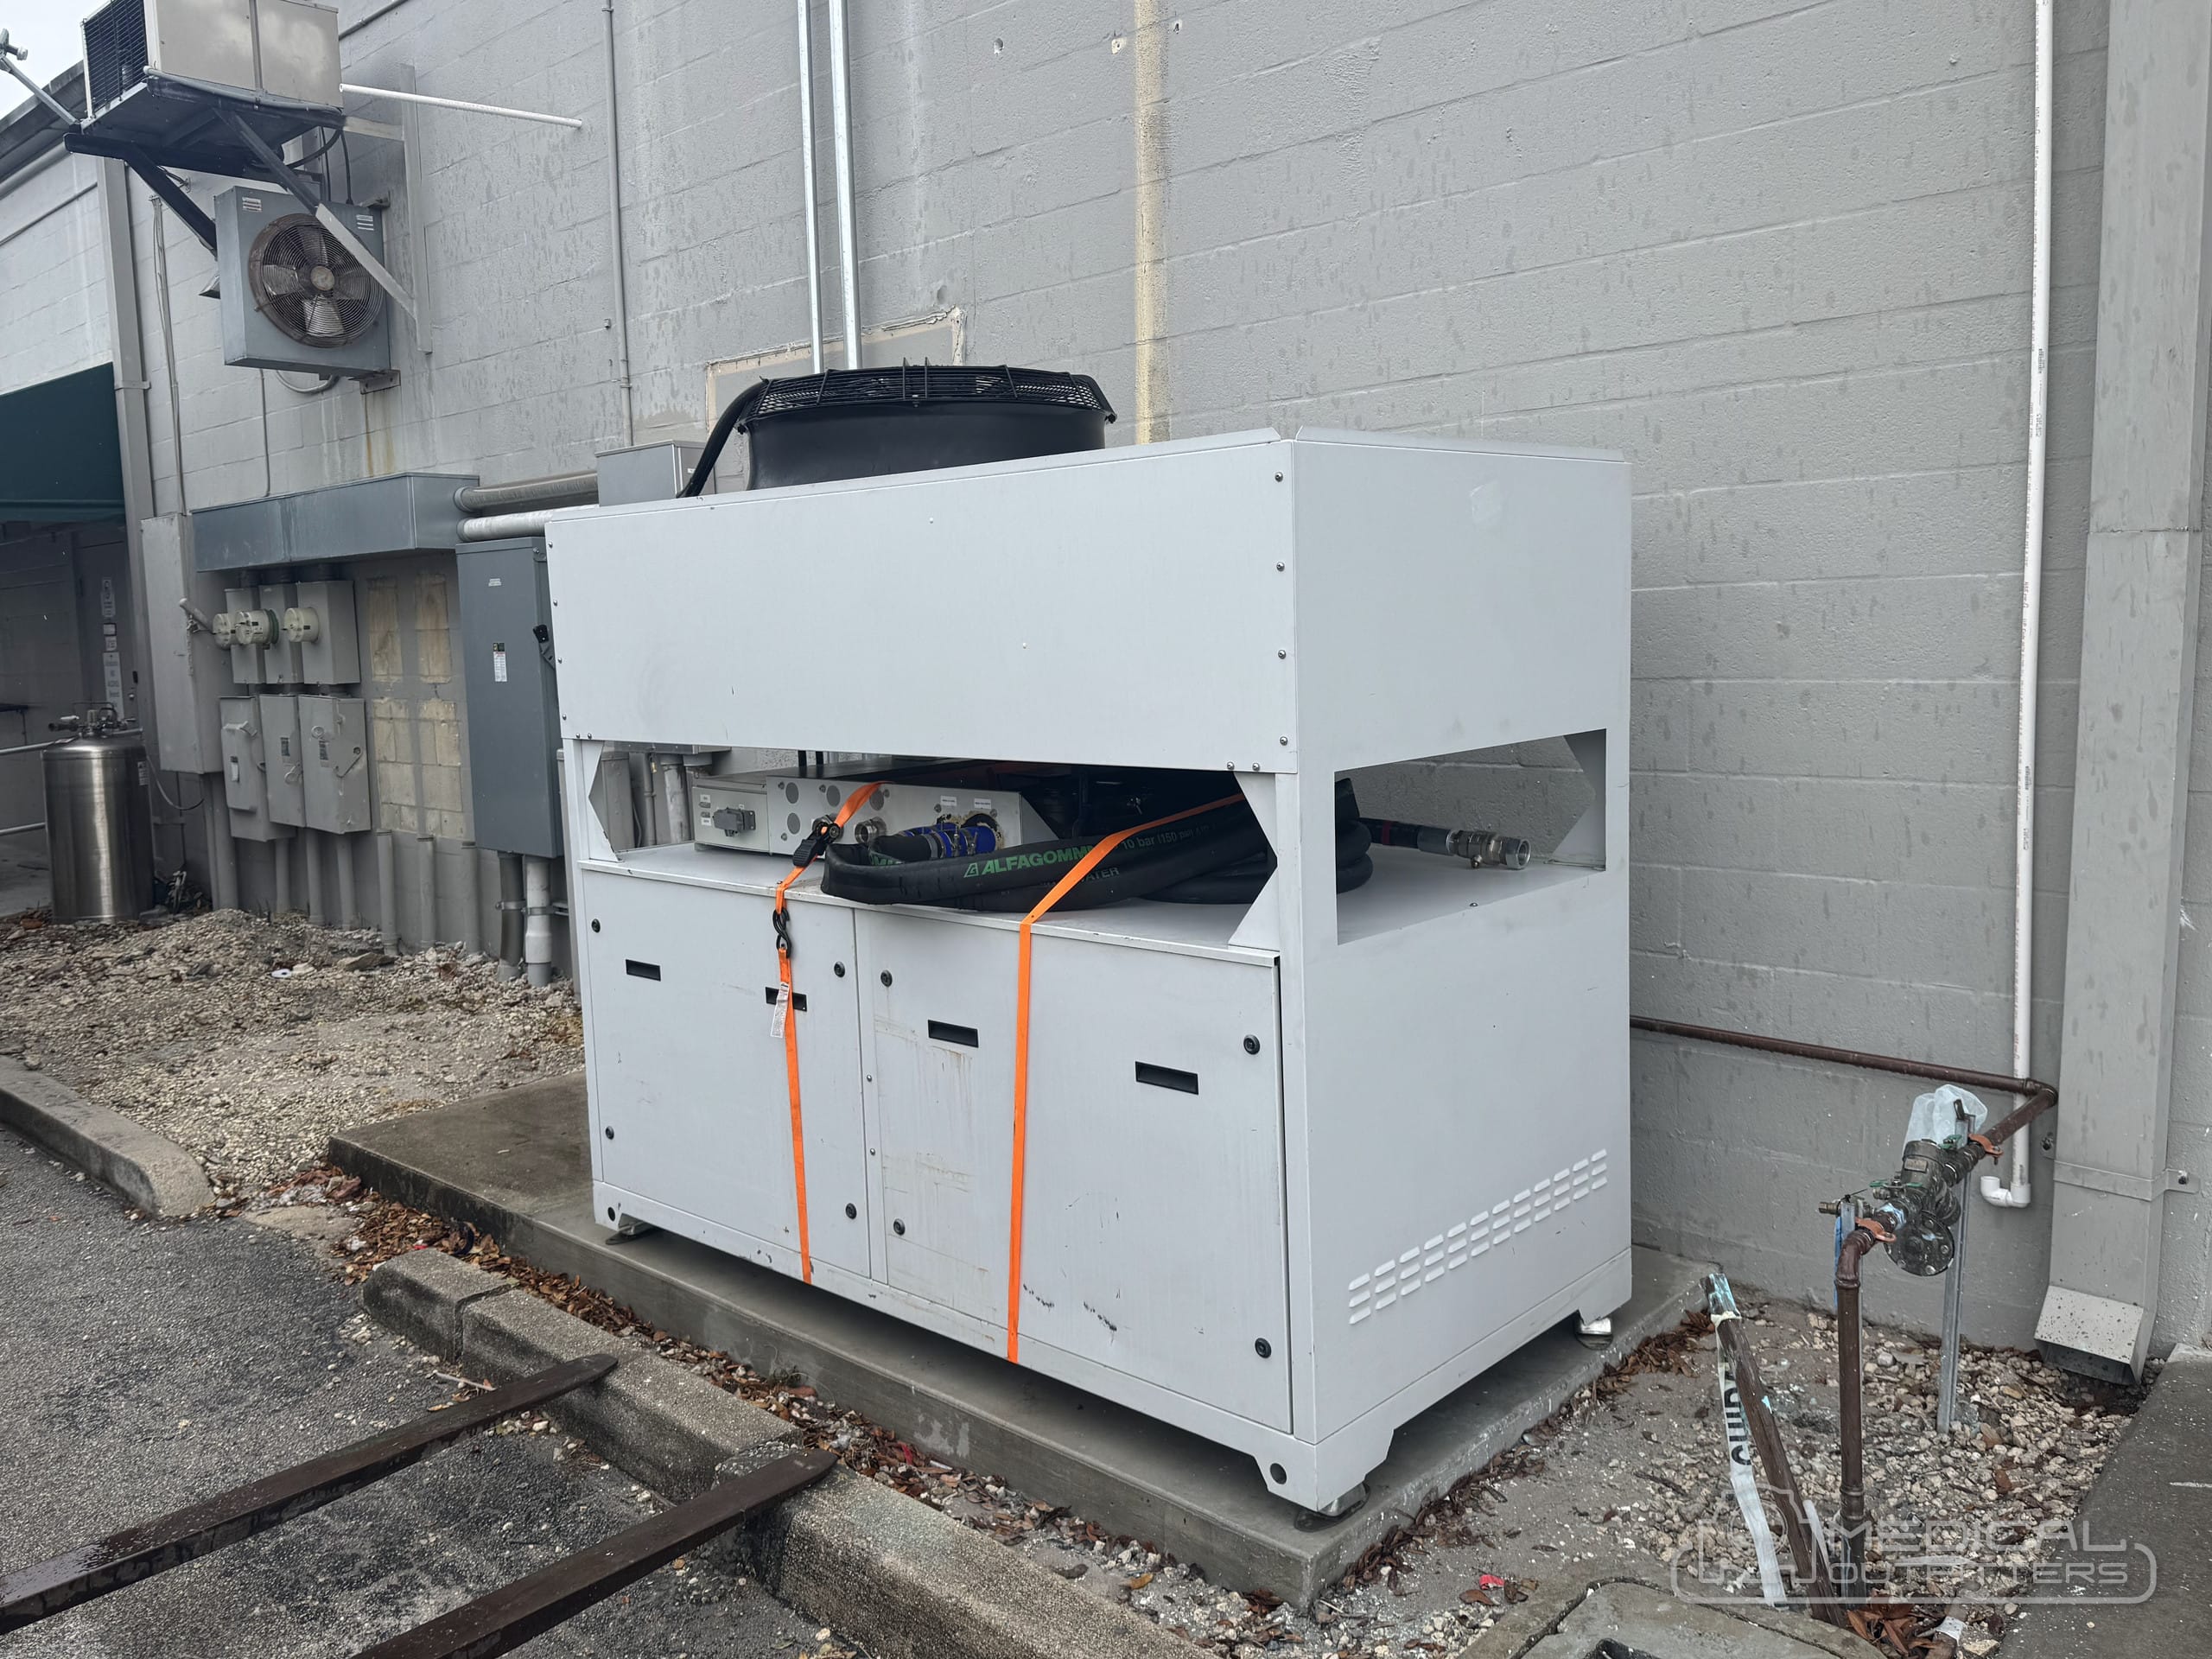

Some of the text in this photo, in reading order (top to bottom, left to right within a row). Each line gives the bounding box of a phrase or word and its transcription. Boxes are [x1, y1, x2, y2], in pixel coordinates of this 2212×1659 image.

[1122, 840, 1135, 850] 10
[1136, 836, 1155, 848] bar
[1081, 867, 1120, 882] ATER
